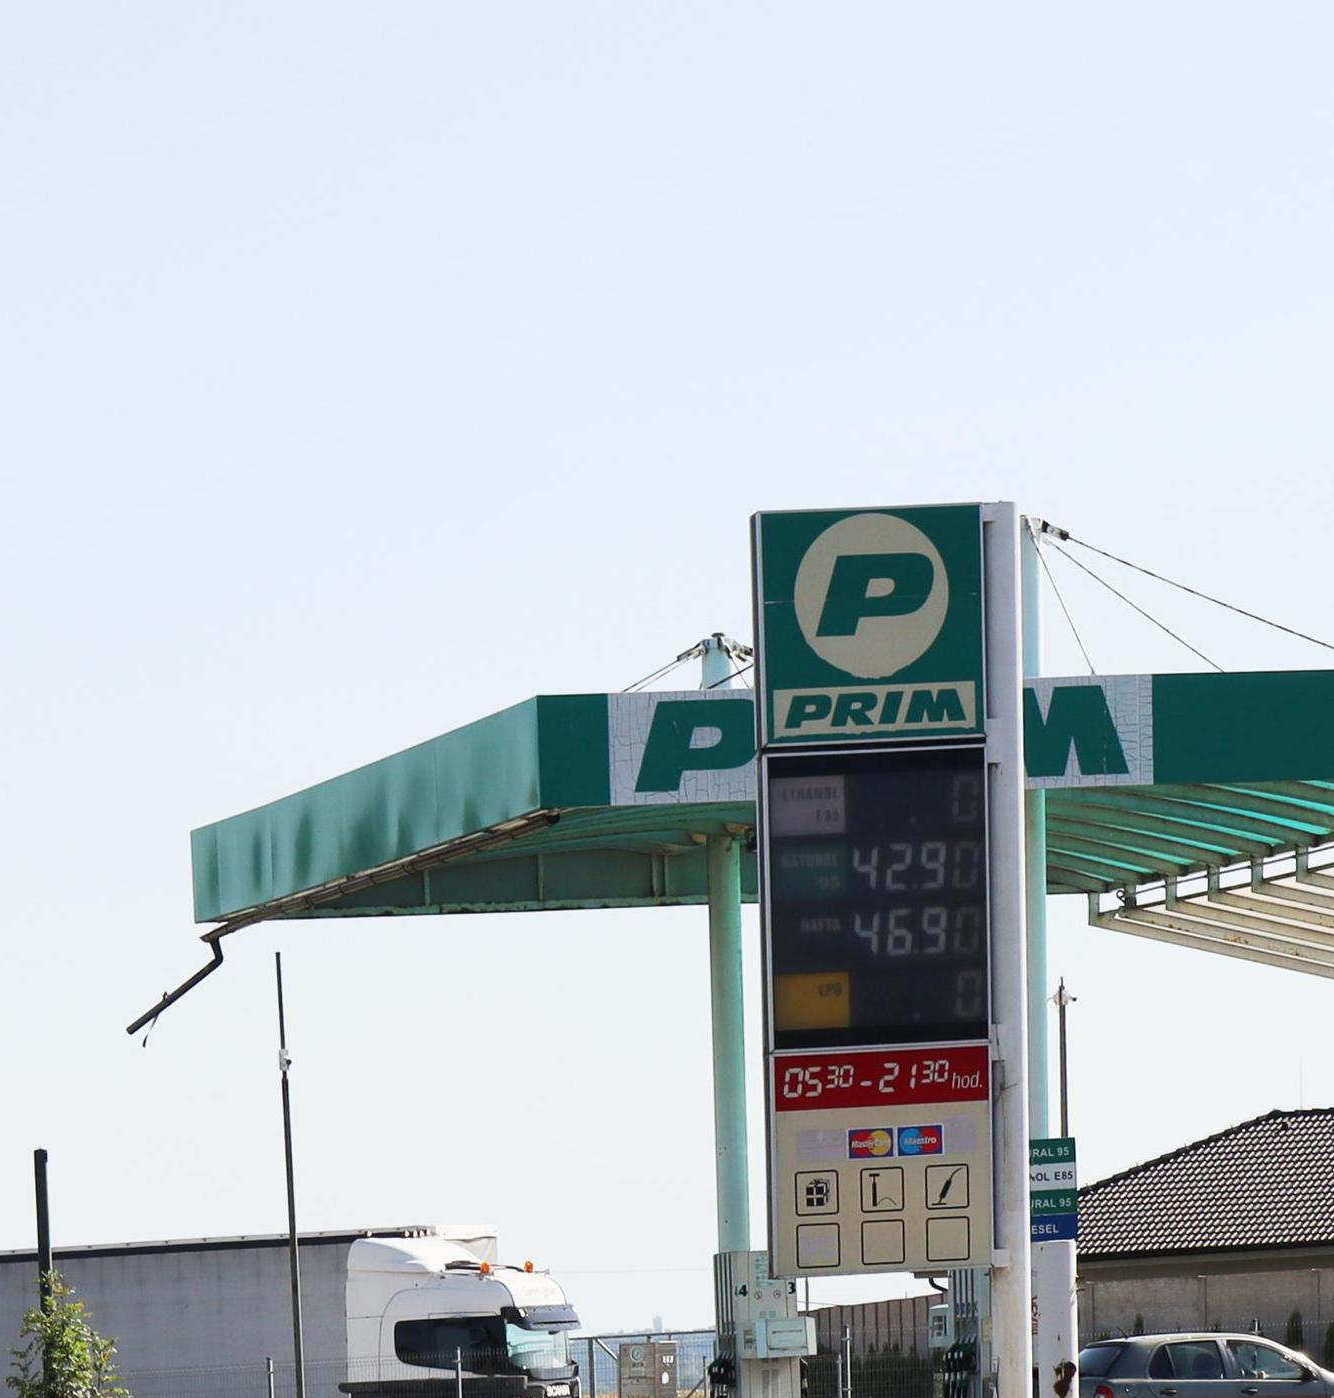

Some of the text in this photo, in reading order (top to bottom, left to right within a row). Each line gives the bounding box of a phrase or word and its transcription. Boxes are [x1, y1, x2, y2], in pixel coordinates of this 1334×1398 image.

[815, 552, 934, 637] P
[784, 689, 967, 729] PRIM
[781, 786, 839, 801] ETHANOL
[818, 982, 842, 998] LPG
[952, 1071, 983, 1090] hod.
[904, 1136, 937, 1146] Maestro
[1030, 1146, 1069, 1158] RAL 95
[1054, 1171, 1073, 1181] E85
[1059, 1197, 1072, 1207] 95
[546, 1384, 571, 1397] SCANIA
